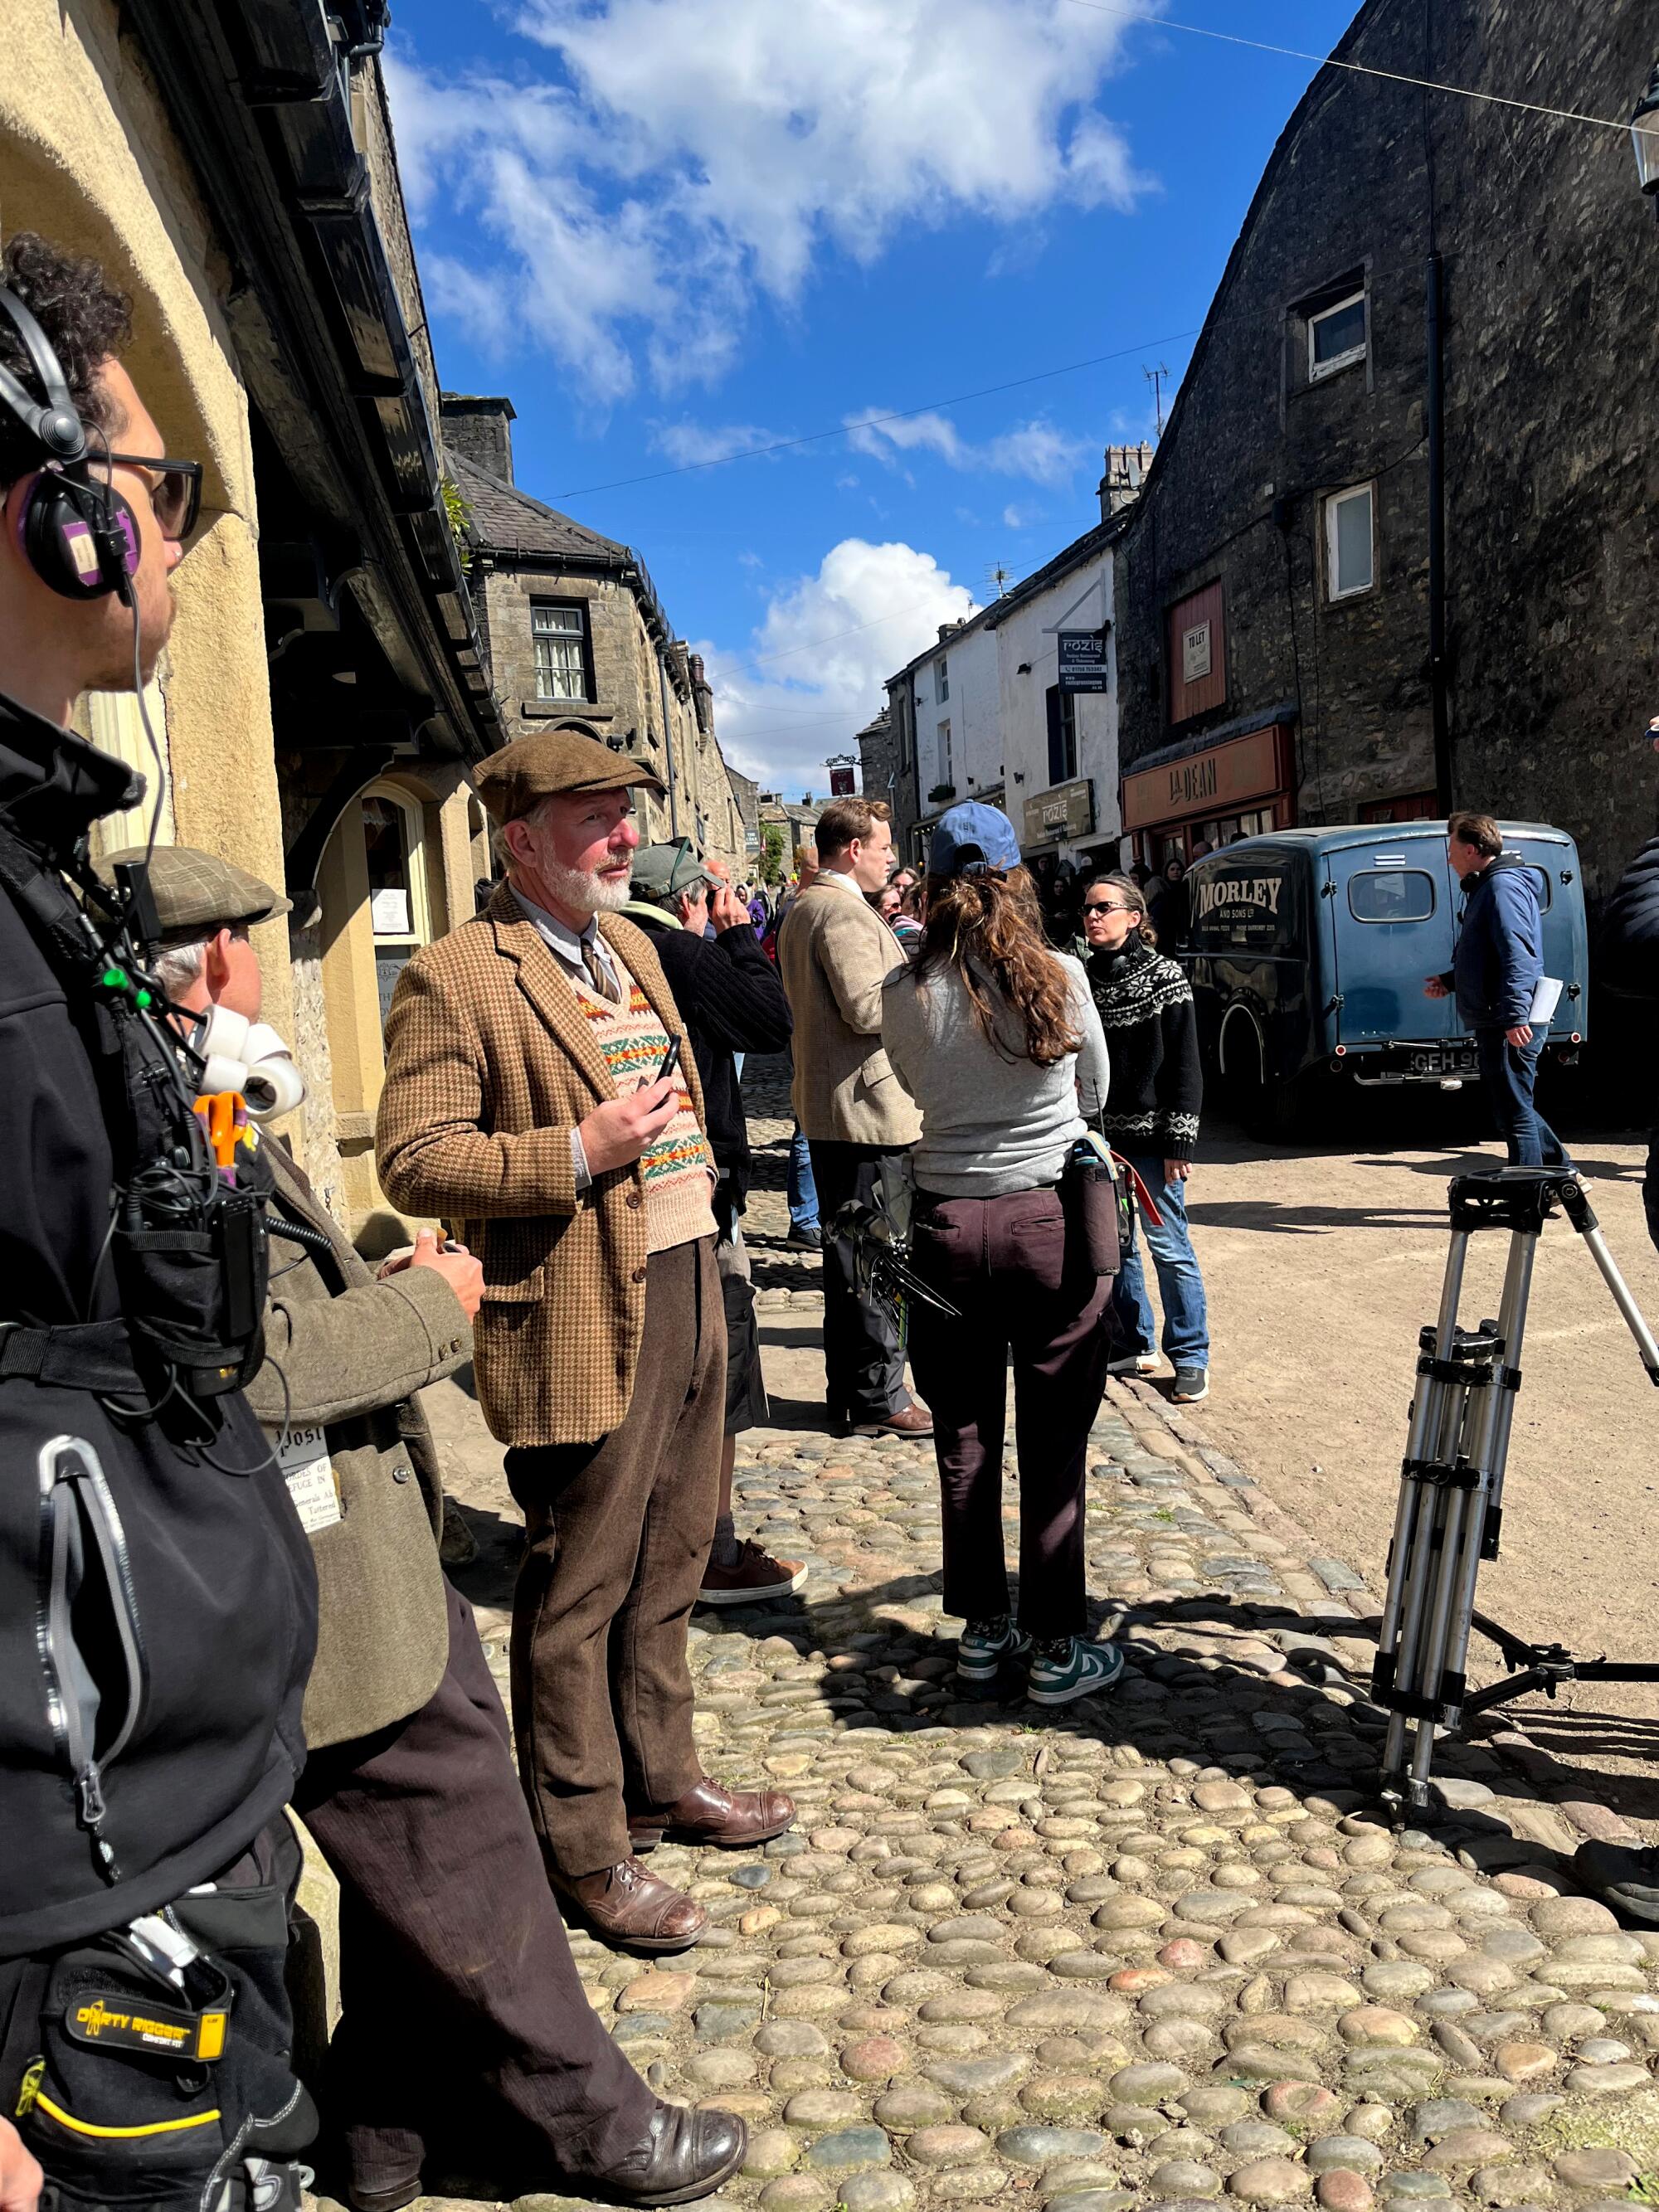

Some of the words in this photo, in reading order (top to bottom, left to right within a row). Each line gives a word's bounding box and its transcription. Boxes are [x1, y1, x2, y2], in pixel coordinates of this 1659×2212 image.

[1189, 636, 1195, 649] TO
[1196, 631, 1205, 645] LET
[1184, 758, 1218, 802] DEAN
[1199, 878, 1282, 919] MORLEY
[1219, 909, 1230, 918] AND
[1232, 909, 1246, 918] SONS
[289, 1478, 313, 1493] EFUGE
